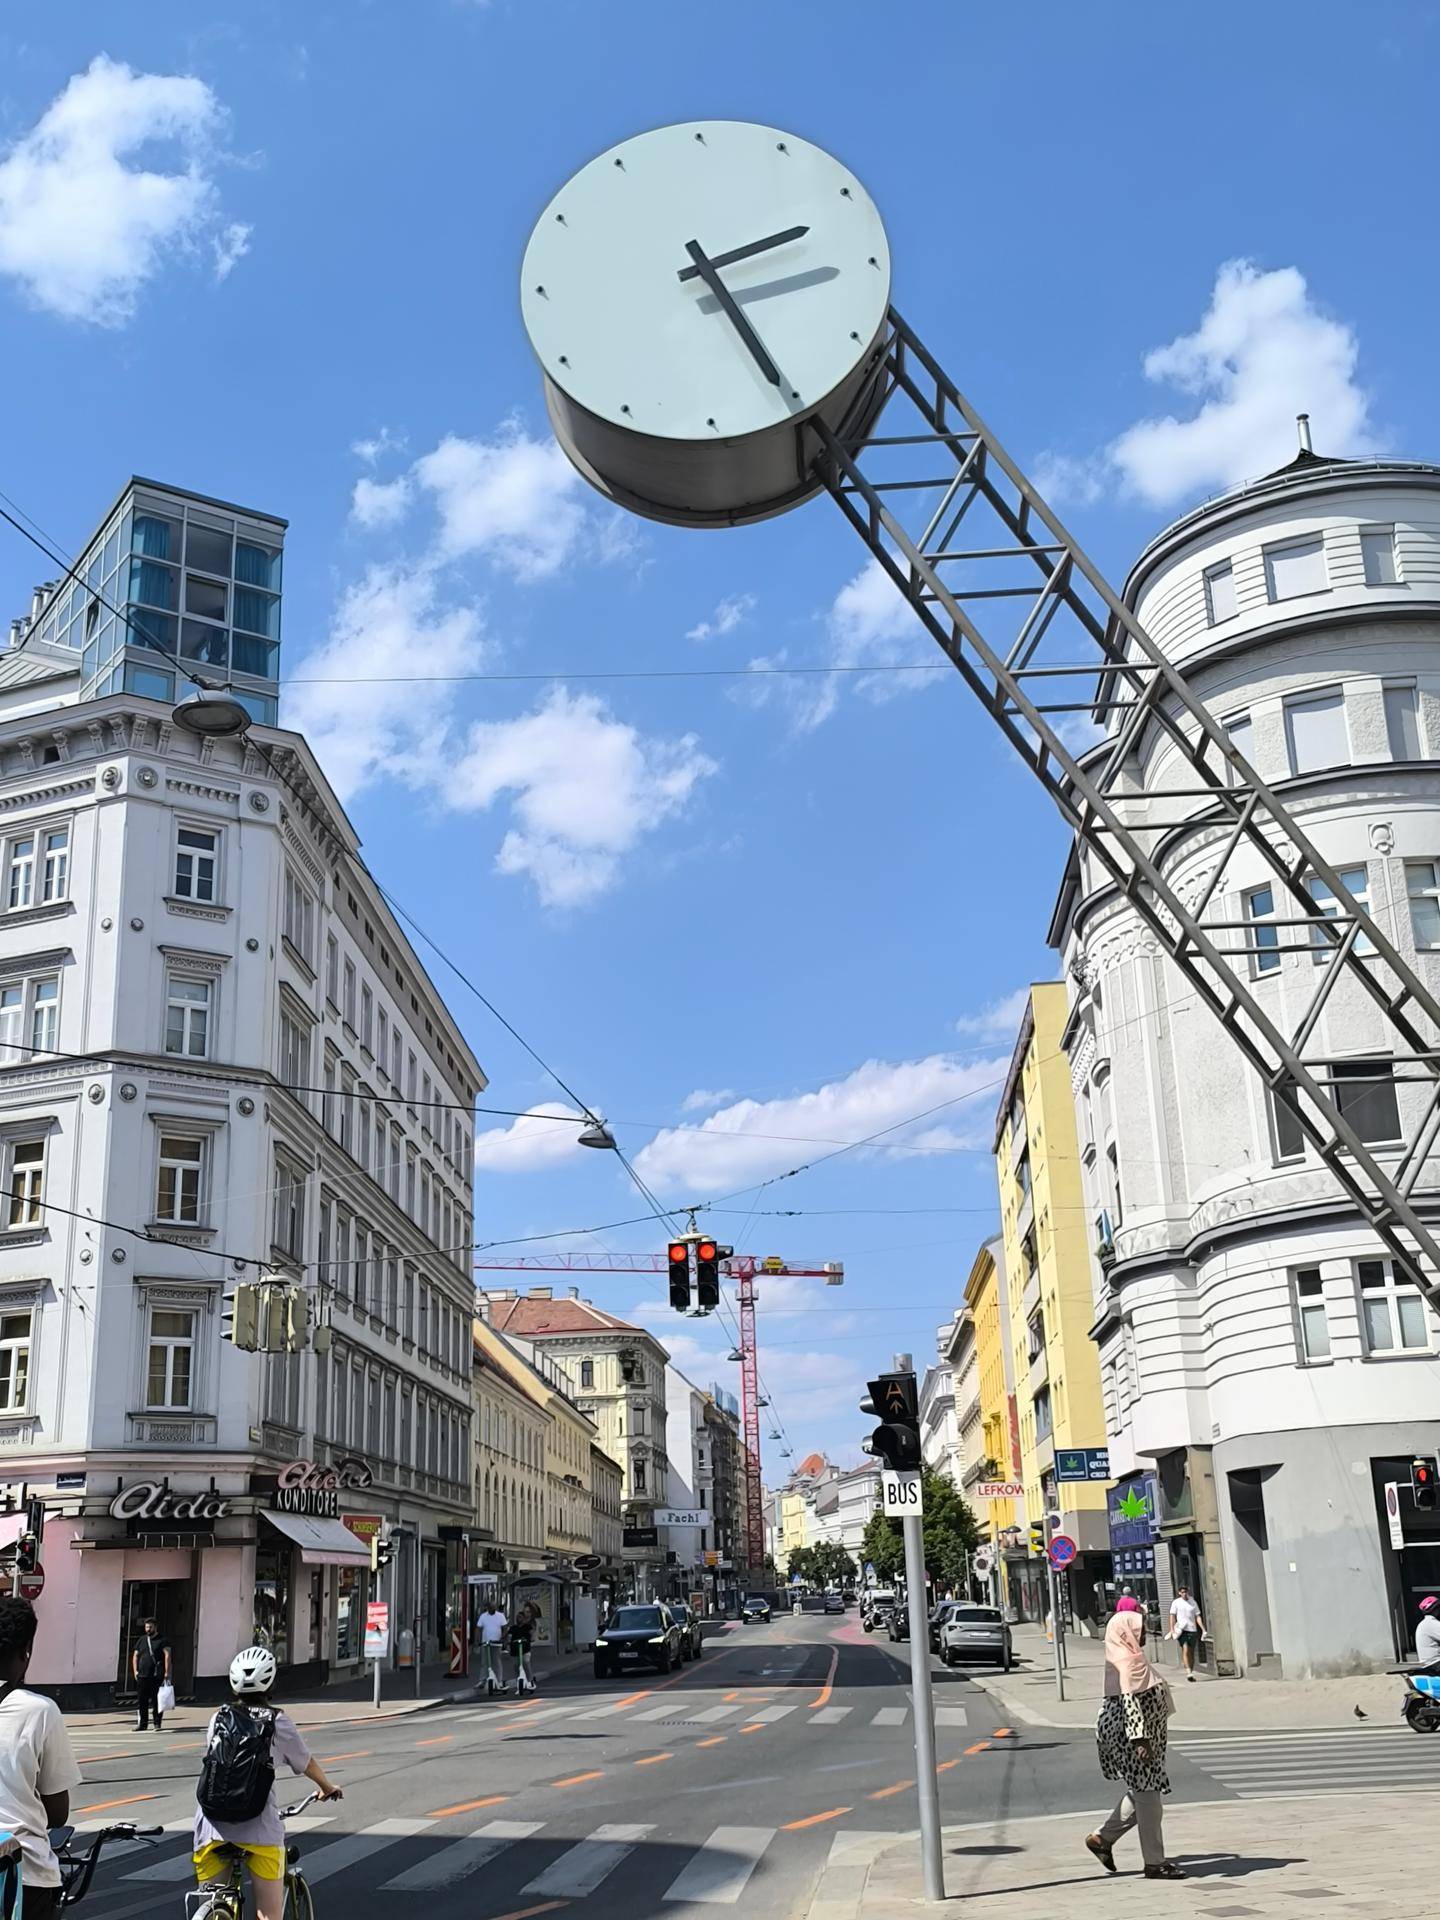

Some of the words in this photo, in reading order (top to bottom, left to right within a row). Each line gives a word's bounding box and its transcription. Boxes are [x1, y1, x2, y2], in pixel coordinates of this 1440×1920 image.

[886, 1381, 905, 1401] A
[109, 1480, 231, 1520] Aida
[888, 1482, 918, 1505] BUS
